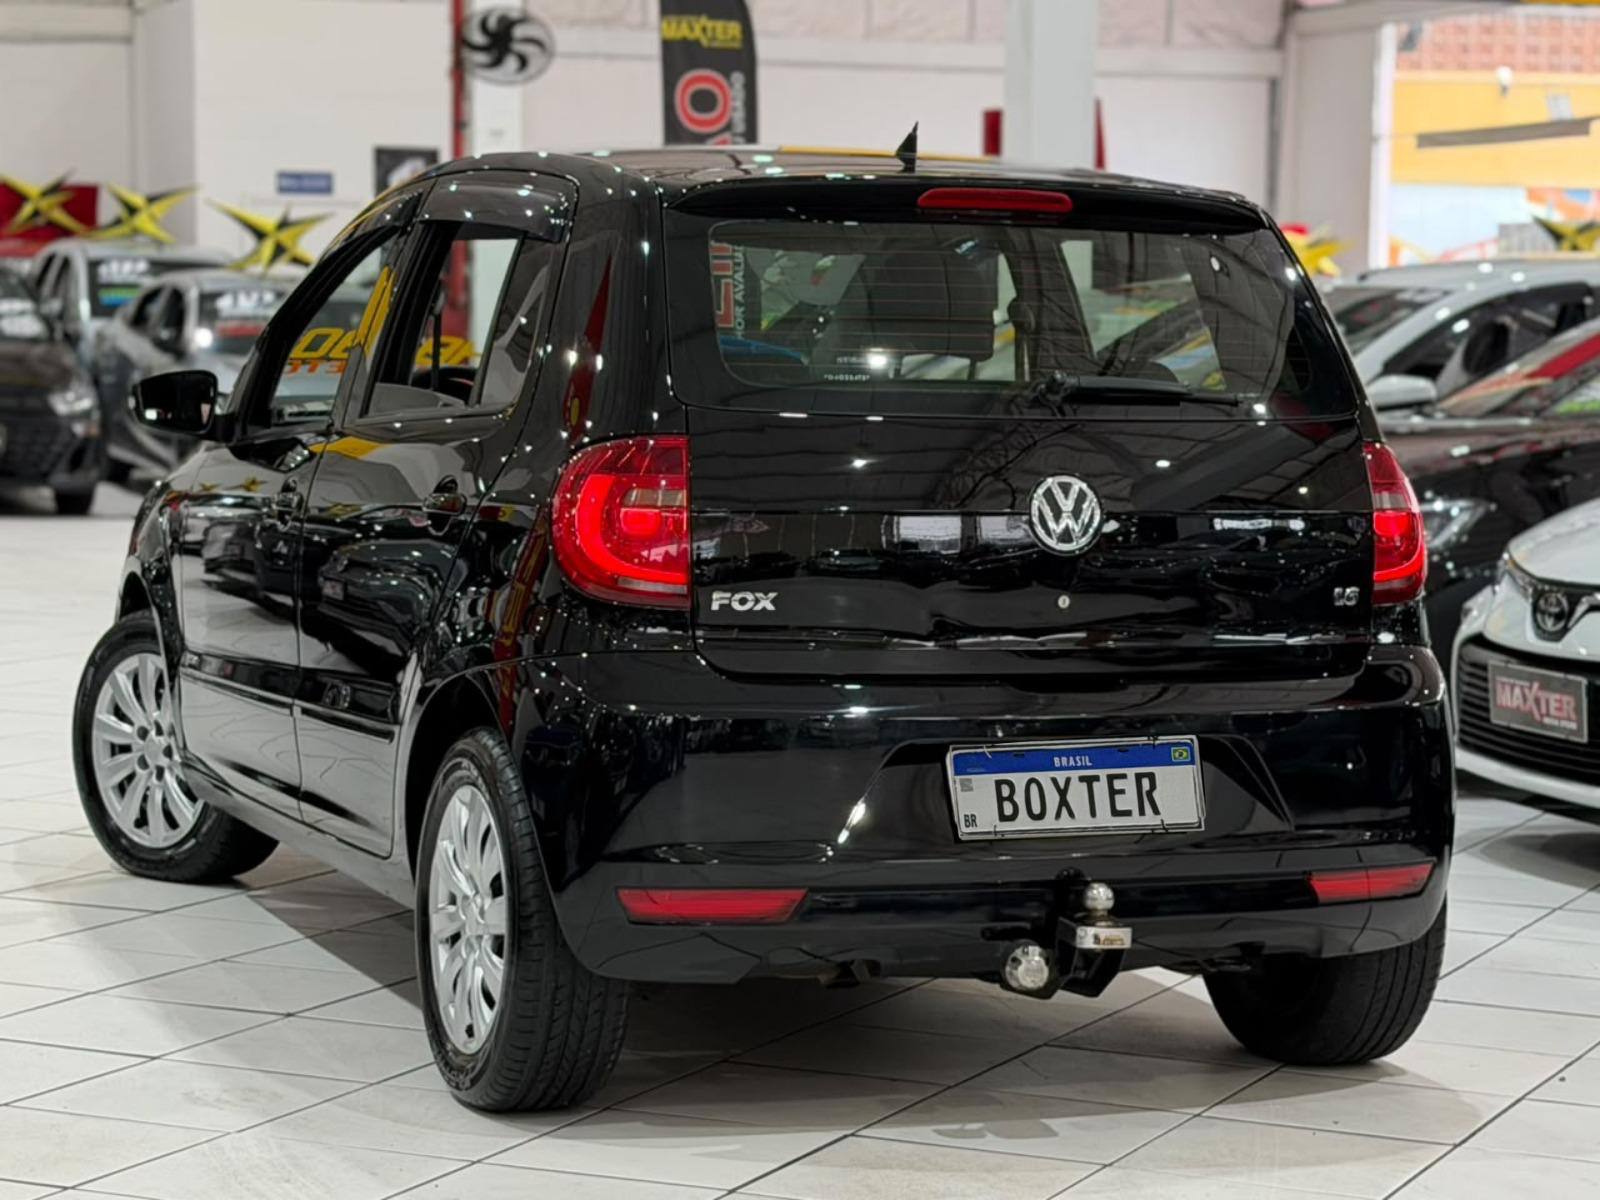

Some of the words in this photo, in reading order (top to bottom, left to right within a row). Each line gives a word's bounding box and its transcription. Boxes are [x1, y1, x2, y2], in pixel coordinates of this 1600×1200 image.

[661, 15, 742, 48] MAXTER
[711, 591, 778, 611] FOX
[1495, 680, 1577, 722] MAXTER
[1053, 755, 1093, 768] BRASIL
[994, 771, 1161, 823] BOXTER
[963, 813, 978, 829] BR
